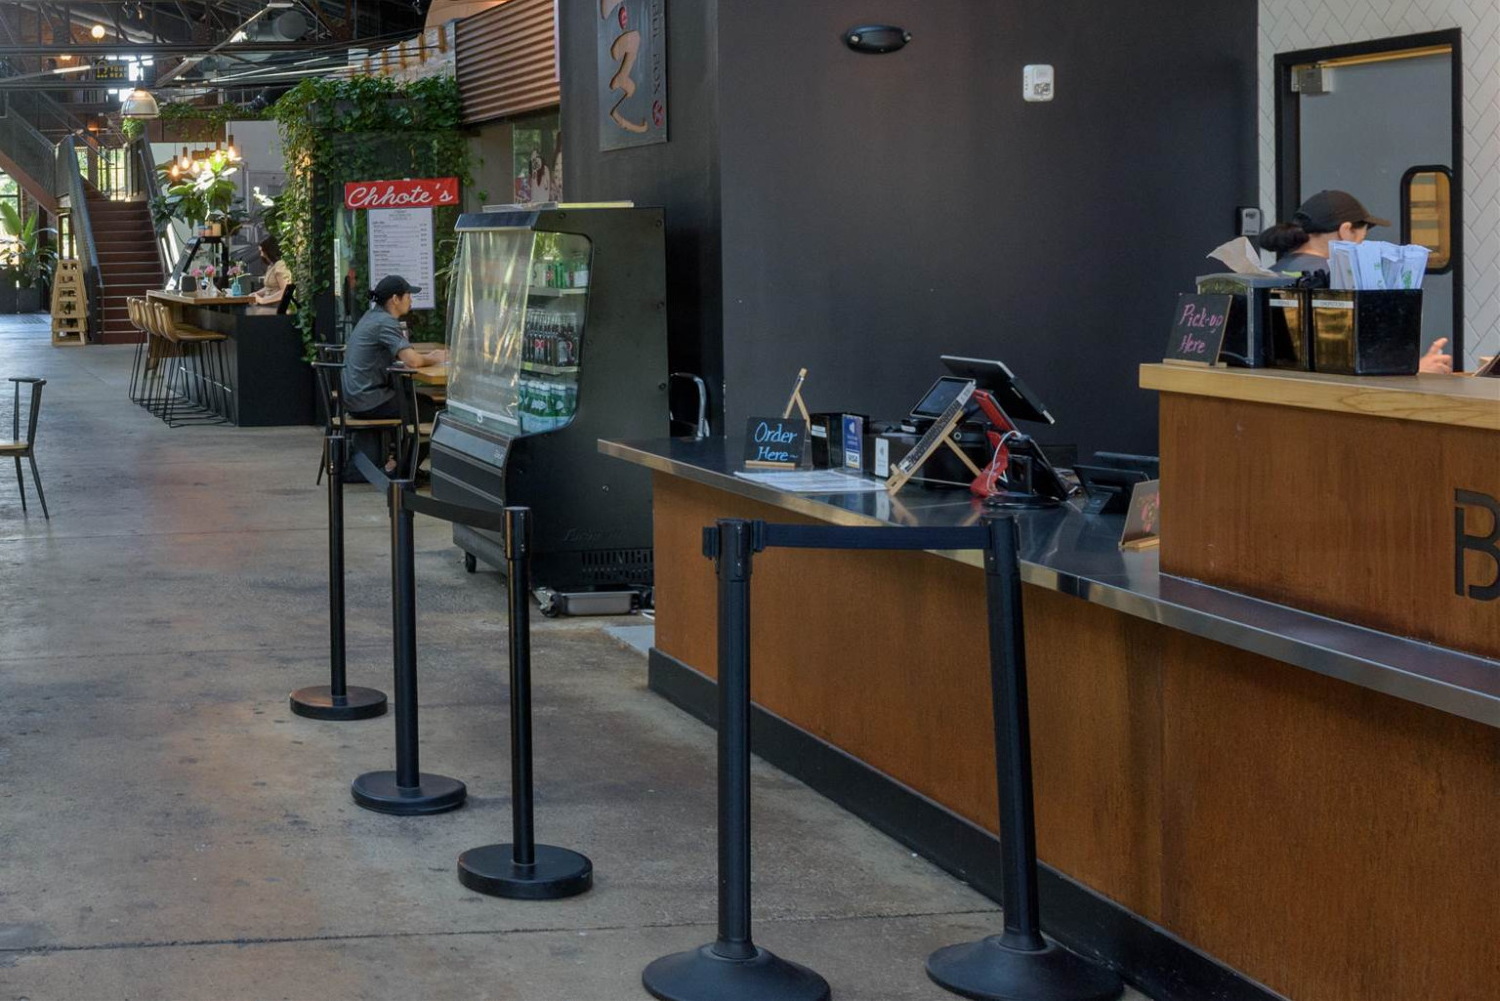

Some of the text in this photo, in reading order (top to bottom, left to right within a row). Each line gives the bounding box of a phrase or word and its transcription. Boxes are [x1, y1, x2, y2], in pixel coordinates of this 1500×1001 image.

[347, 183, 453, 207] Chhote's
[1179, 303, 1224, 333] Pick-up
[1180, 333, 1206, 353] Here
[754, 421, 798, 444] Order
[756, 446, 789, 461] Here
